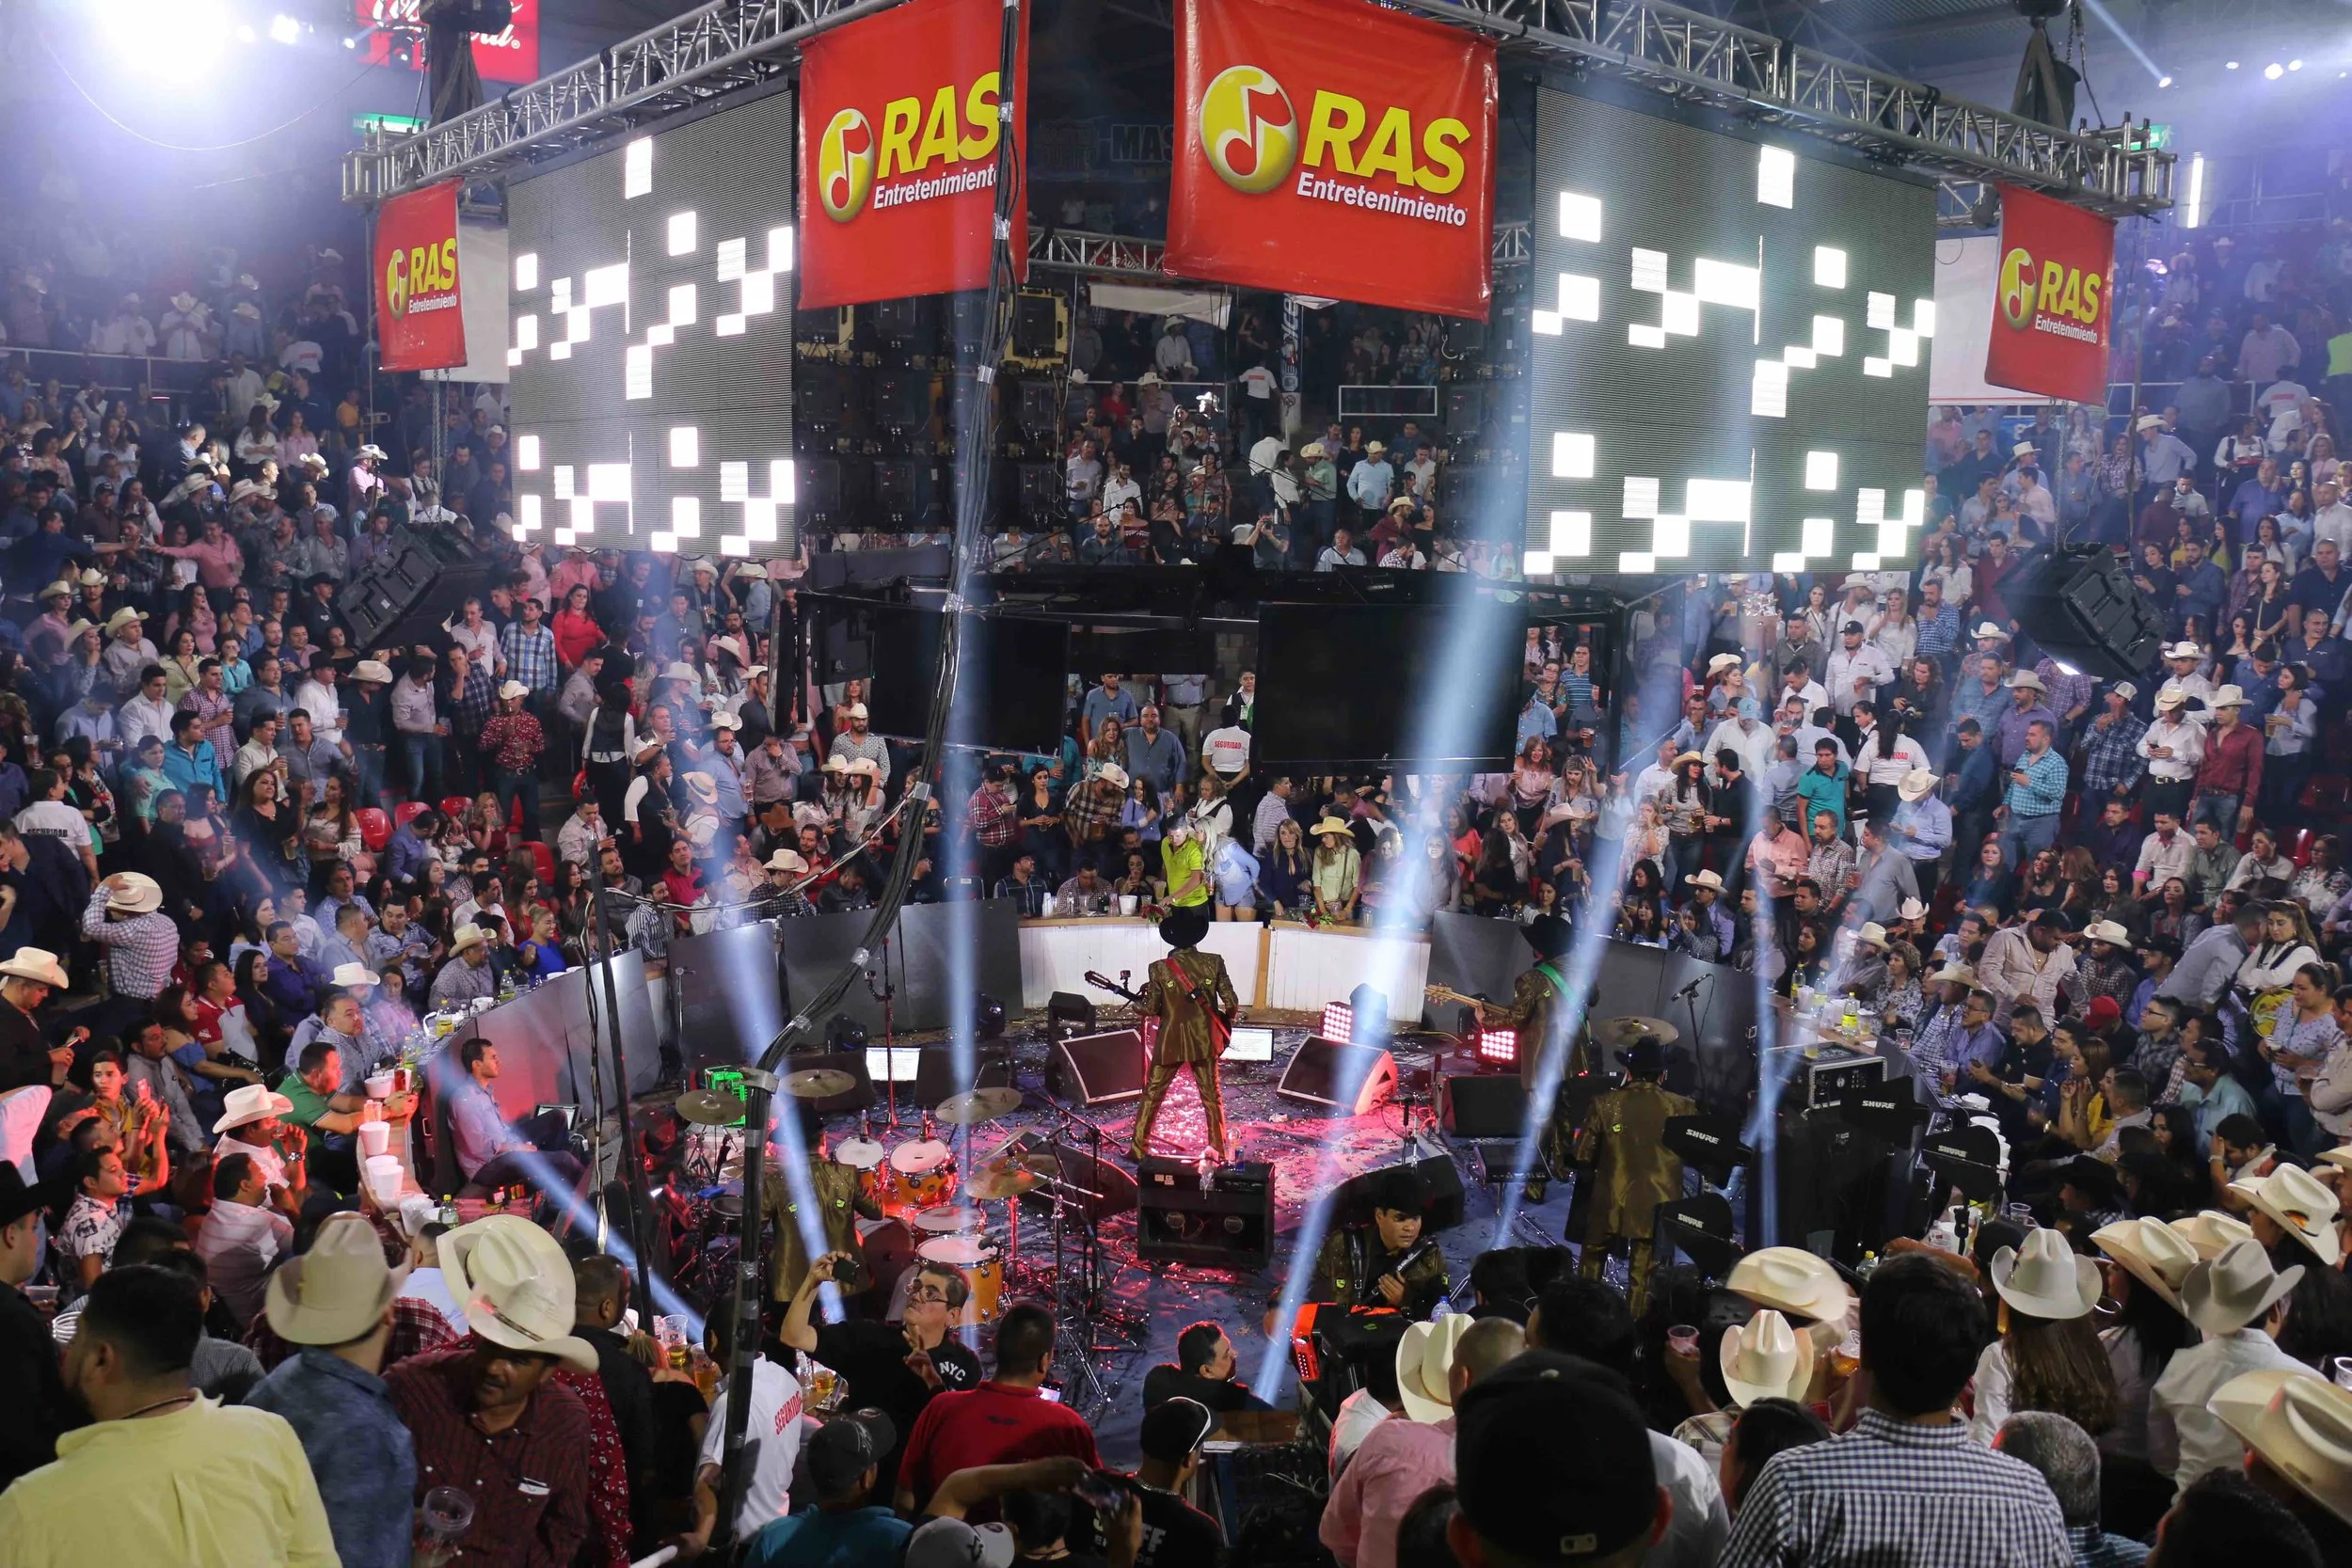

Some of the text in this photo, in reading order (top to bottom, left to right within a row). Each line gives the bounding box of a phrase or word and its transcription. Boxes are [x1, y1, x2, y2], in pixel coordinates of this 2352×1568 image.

[877, 71, 1000, 180] RAS
[1302, 89, 1470, 195] RAS
[873, 163, 996, 210] Entretenimient
[1296, 171, 1467, 227] Entretenimiento
[409, 237, 456, 295] RAS
[408, 293, 457, 314] Entretenimiento
[2037, 260, 2101, 324] RAS
[2035, 313, 2098, 344] Entretenimiento
[1862, 1100, 1896, 1110] SHURE
[1685, 1128, 1719, 1145] SHURE
[1938, 1145, 1967, 1158] SHURE
[1677, 1212, 1704, 1228] SHURE
[939, 1360, 966, 1382] NYC
